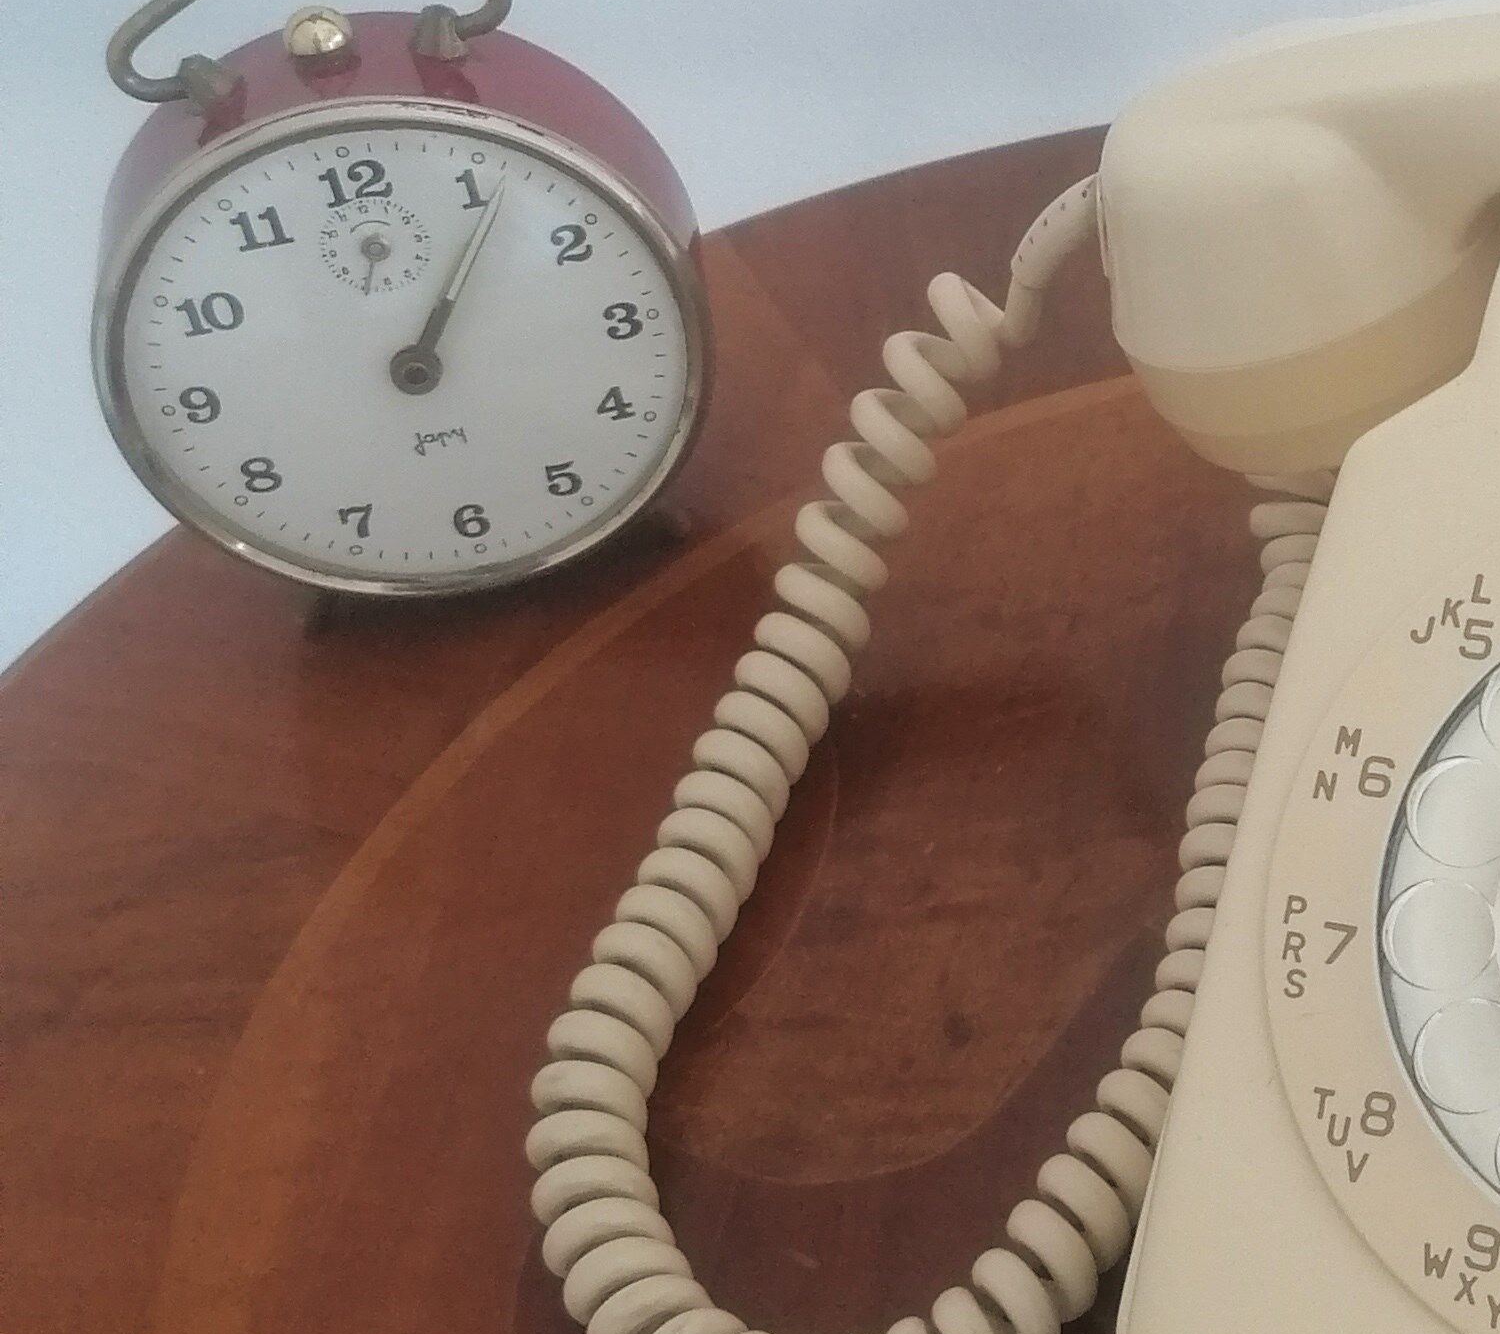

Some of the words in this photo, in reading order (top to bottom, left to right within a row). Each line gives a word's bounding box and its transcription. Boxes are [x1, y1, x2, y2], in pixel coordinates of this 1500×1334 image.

[318, 158, 394, 209] 12
[455, 169, 490, 210] 1
[228, 205, 296, 253] 11
[550, 223, 594, 266] 2
[173, 291, 245, 338] 10
[602, 302, 644, 341] 3
[178, 386, 221, 424] 9
[596, 386, 637, 422] 4
[239, 457, 283, 494] 8
[544, 460, 583, 497] 5
[337, 503, 373, 539] 7
[452, 504, 491, 539] 6
[1458, 617, 1495, 661] 5
[1357, 755, 1396, 799] 6
[1323, 921, 1359, 965] 7
[1359, 1090, 1397, 1138] 8
